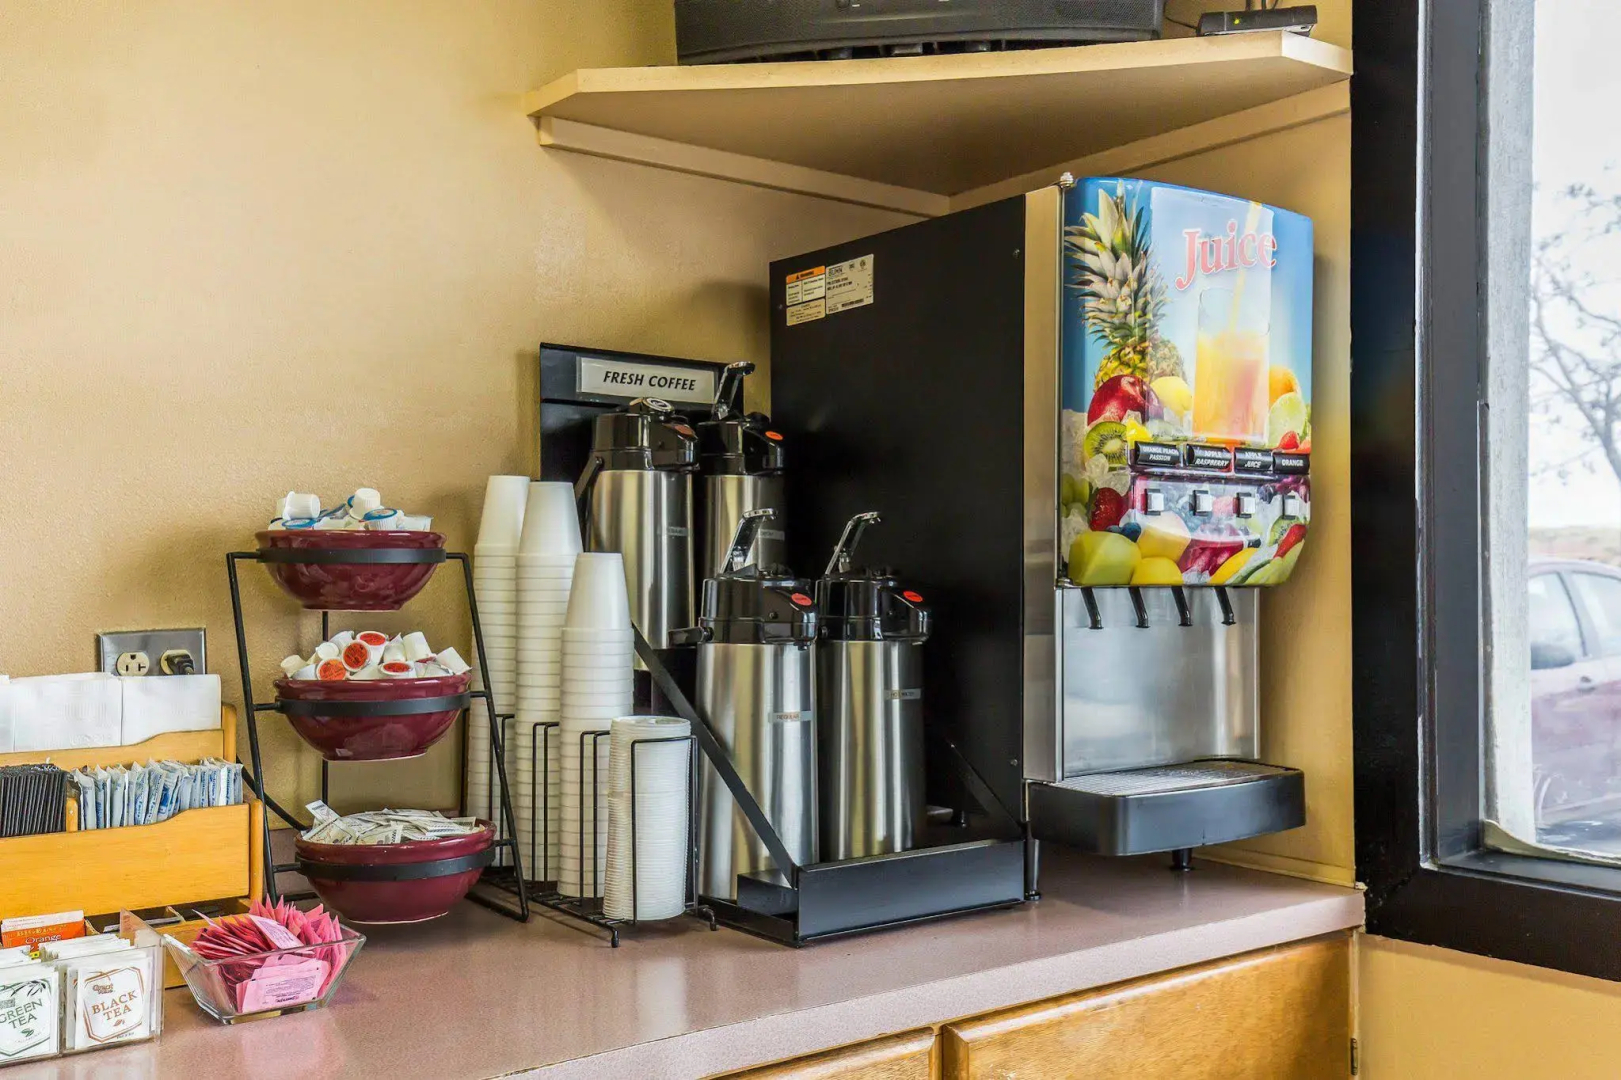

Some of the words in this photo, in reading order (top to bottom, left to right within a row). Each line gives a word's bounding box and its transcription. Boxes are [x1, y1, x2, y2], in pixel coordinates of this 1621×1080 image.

[1175, 218, 1277, 290] Juice
[603, 371, 645, 386] FRESH
[648, 375, 697, 391] COFFEE
[1149, 454, 1172, 462] PASSION
[1195, 458, 1229, 468] RASPBERRY
[1244, 460, 1262, 469] JUICE
[1281, 459, 1304, 467] ORANGE
[25, 934, 62, 945] Orange
[91, 990, 138, 1015] BLACK
[0, 998, 43, 1024] GREEN
[103, 1004, 132, 1021] TEA
[8, 1013, 38, 1029] TEA
